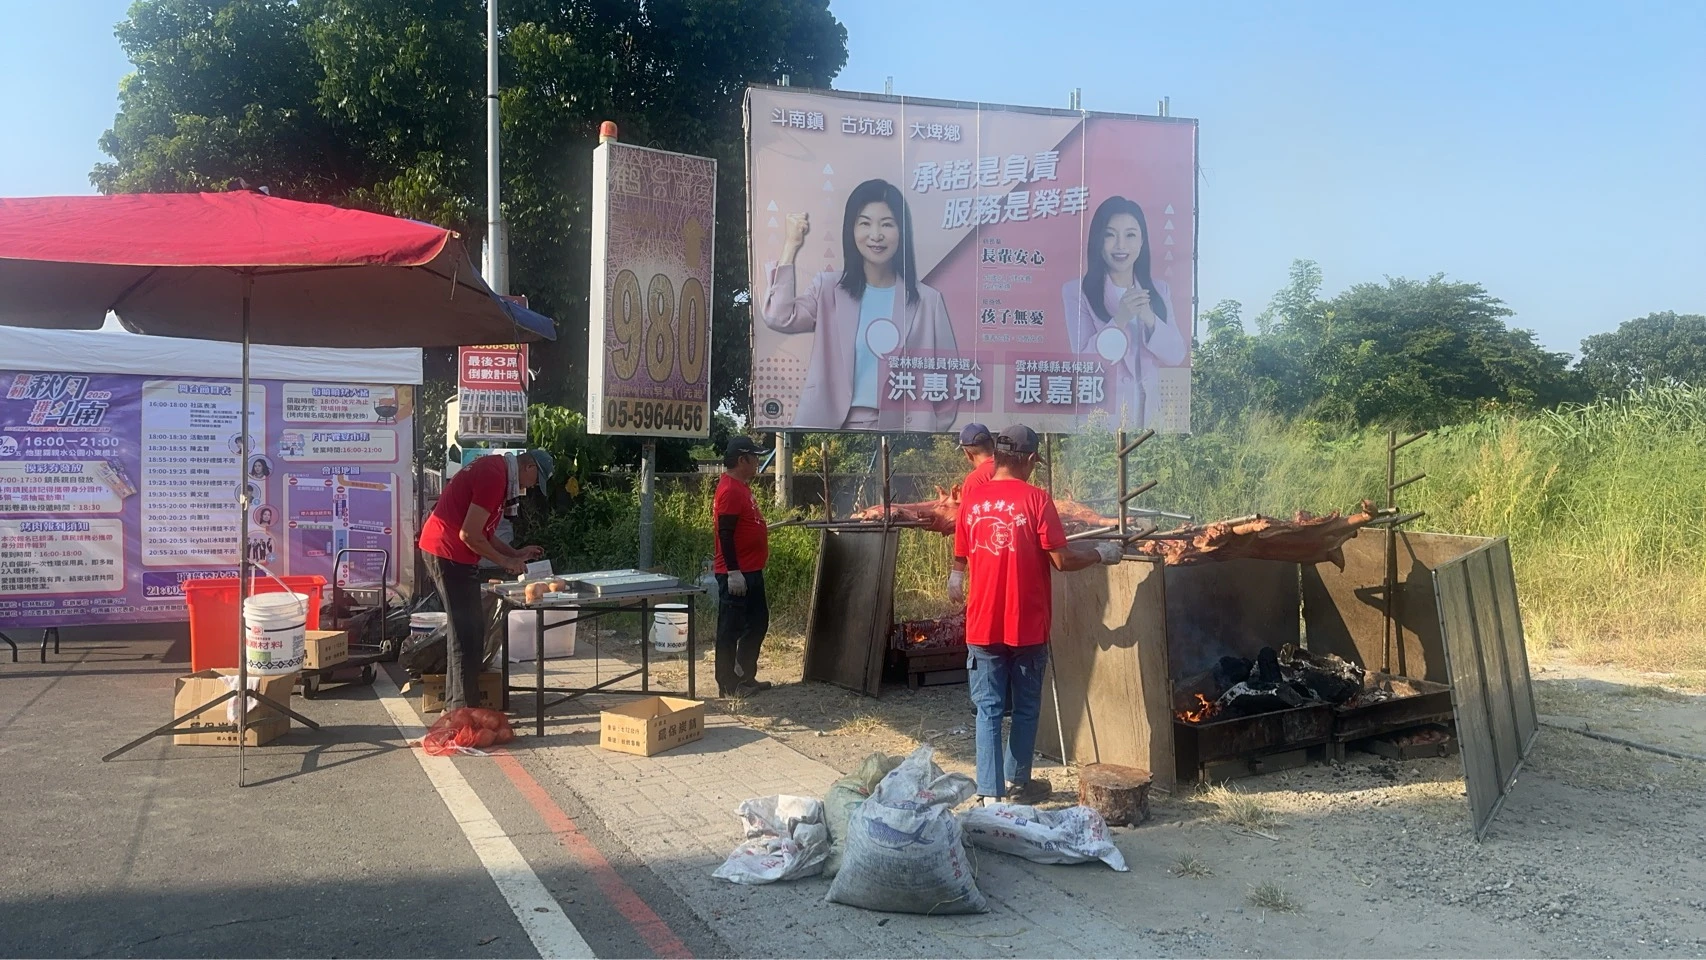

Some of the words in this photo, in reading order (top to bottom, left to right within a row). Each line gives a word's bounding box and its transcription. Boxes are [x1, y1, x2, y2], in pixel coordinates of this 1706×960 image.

[771, 107, 825, 131] 斗南鎮
[841, 115, 893, 138] 古坑鄉
[909, 121, 961, 143] 大埤鄉
[911, 150, 1059, 194] 承諾是負責
[941, 186, 1090, 230] 服務是榮幸
[981, 247, 1045, 265] 長輩安心
[612, 269, 706, 385] 980
[981, 307, 1044, 326] 孩子無憂
[468, 355, 517, 368] 最後3席
[888, 355, 982, 371] 雲林縣議員候選人
[1015, 359, 1105, 374] 雲林縣縣長候選人
[468, 369, 519, 381] 倒數計時
[888, 371, 982, 401] 洪惠玲
[1014, 374, 1105, 405] 張嘉郡
[607, 399, 703, 432] 05-5964456
[0, 476, 42, 484] 7:00-17:30
